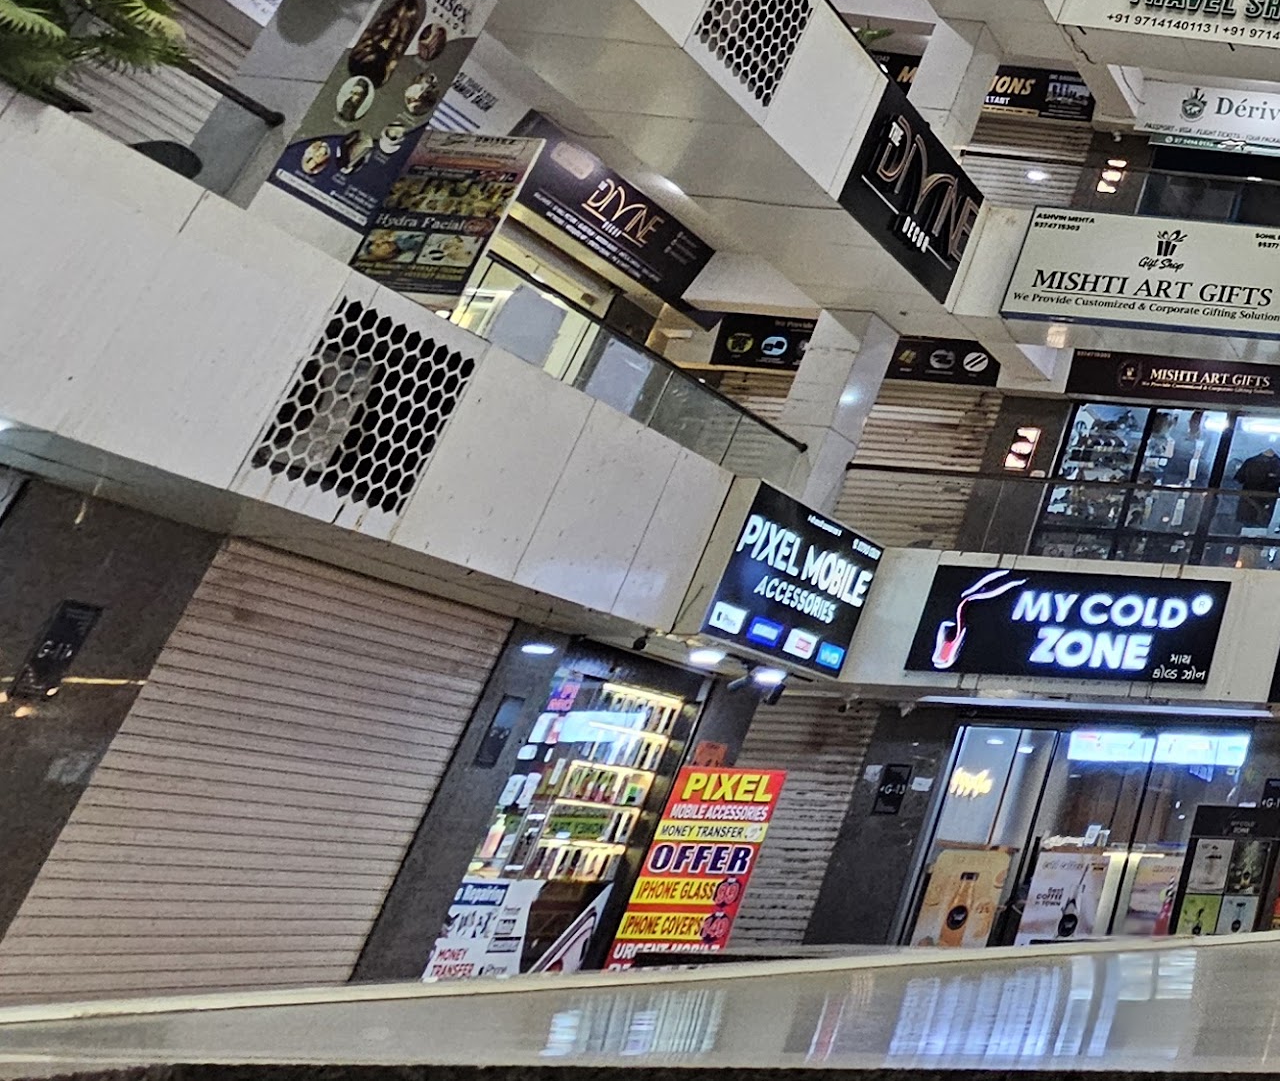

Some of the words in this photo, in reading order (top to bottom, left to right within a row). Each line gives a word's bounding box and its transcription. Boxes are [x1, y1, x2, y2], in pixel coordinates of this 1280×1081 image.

[1106, 12, 1130, 24] +91
[1133, 16, 1211, 34] 9714140113
[1223, 26, 1245, 37] +91
[377, 213, 418, 227] Hydra
[424, 217, 462, 231] Facial
[1139, 256, 1158, 269] Gift
[1159, 259, 1184, 272] Shop
[1031, 269, 1129, 295] MISHTI
[1133, 279, 1192, 300] ART
[1200, 283, 1272, 306] GIFTS
[1013, 292, 1030, 302] We
[1032, 292, 1072, 305] Provide
[1074, 296, 1136, 311] Customized
[1138, 303, 1145, 311] &
[1149, 303, 1200, 316] Corporate
[1202, 306, 1236, 320] Gifting
[1240, 309, 1280, 321] Solution
[1150, 369, 1198, 383] MISHTI
[1200, 371, 1230, 385] ART
[1232, 375, 1270, 388] GIFTS
[736, 514, 801, 576] PIXEL
[801, 545, 872, 607] MOBILE
[754, 576, 837, 624] ACCESSORIES
[1012, 591, 1080, 623] MY
[1079, 593, 1188, 629] COLD
[1029, 627, 1152, 671] ZONE
[682, 773, 772, 802] PIXEL
[670, 804, 707, 819] MOBILE
[706, 804, 768, 821] ACCESSORIES
[661, 825, 695, 836] MONEY
[698, 826, 744, 837] TRANSFER
[649, 844, 753, 874] OFFER
